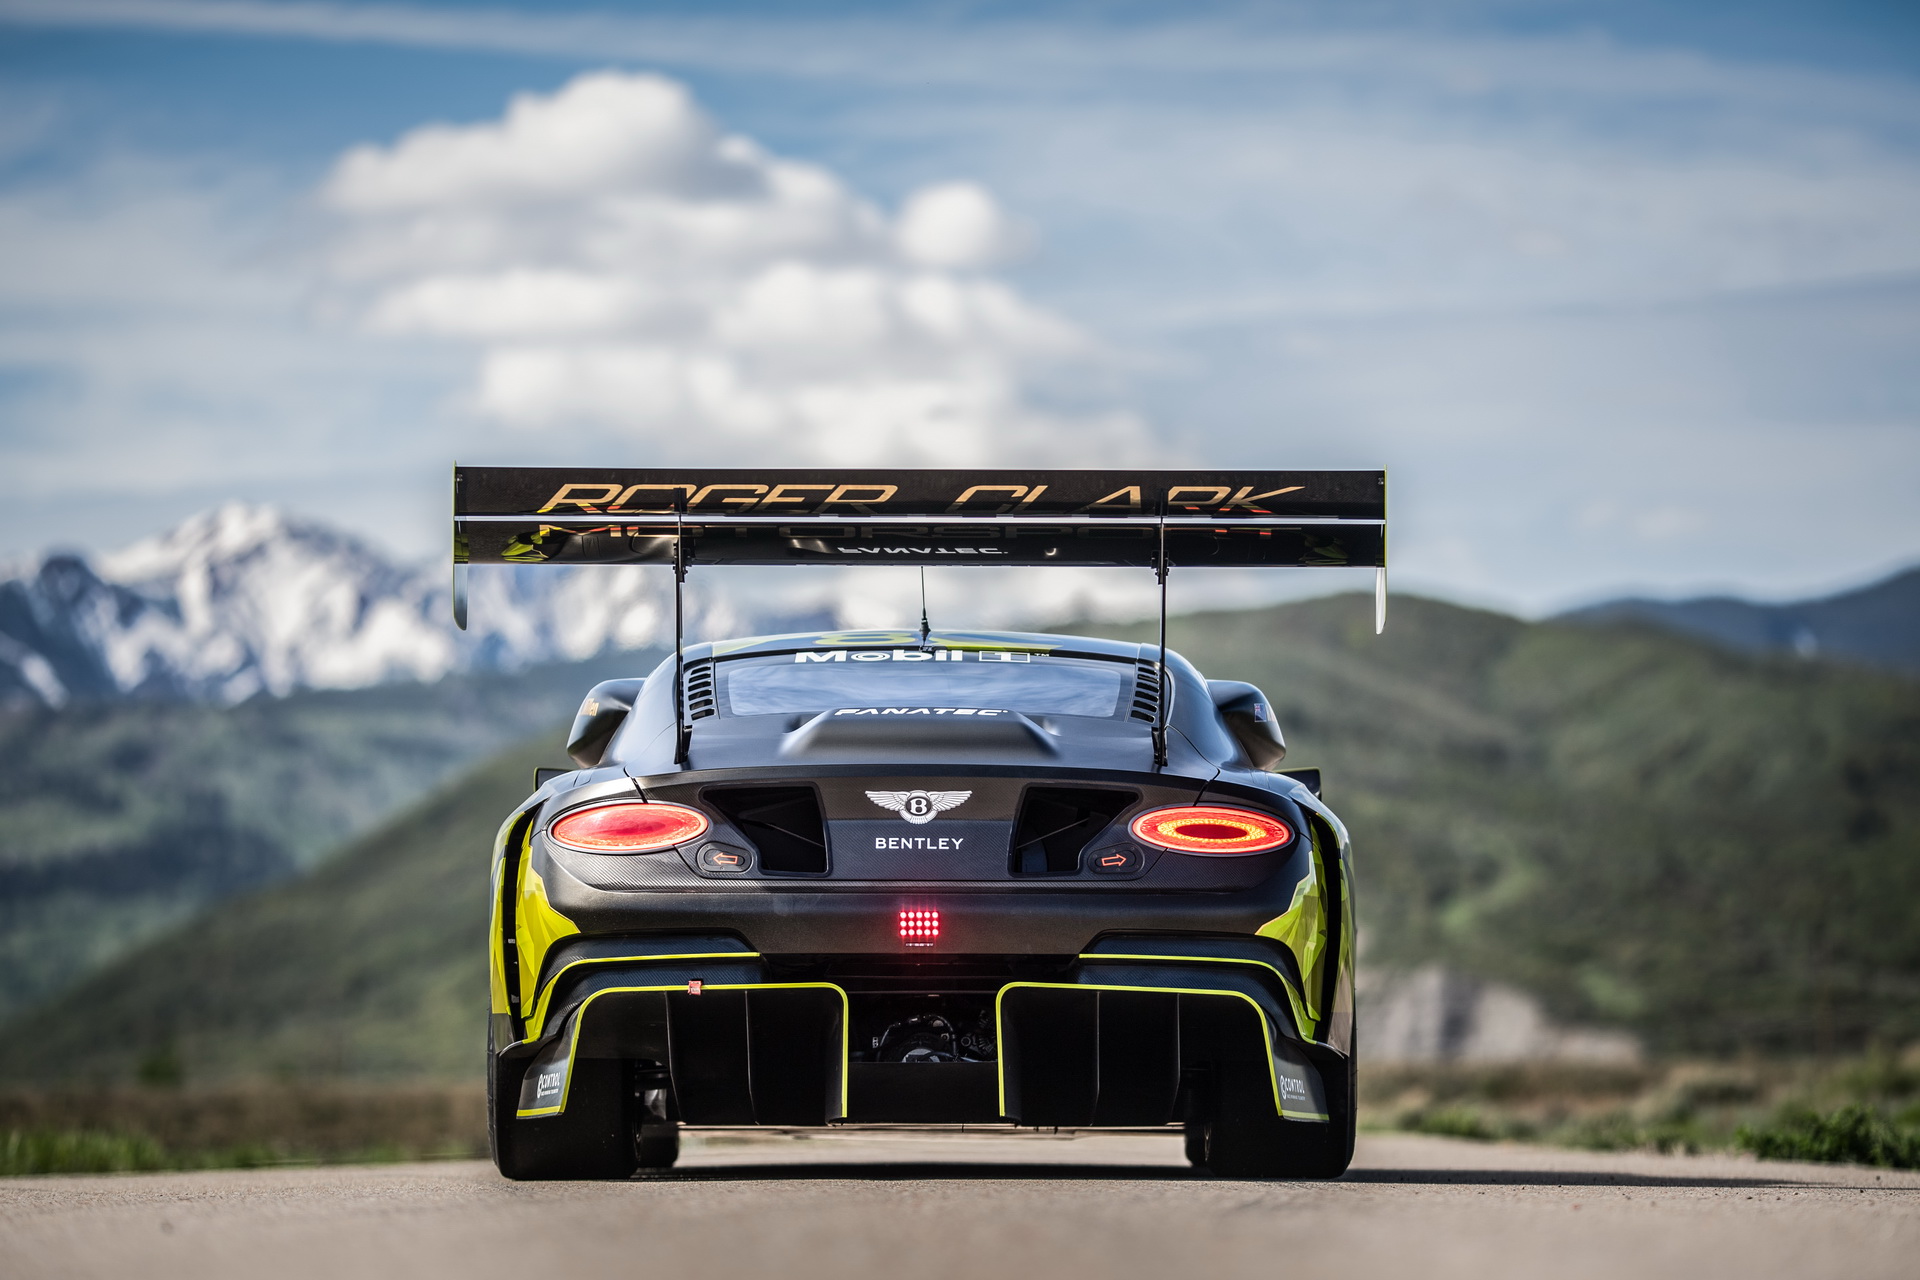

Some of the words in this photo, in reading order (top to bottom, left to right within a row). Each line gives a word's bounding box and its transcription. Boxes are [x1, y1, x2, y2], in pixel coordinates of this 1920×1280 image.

[537, 483, 898, 513] ROGER
[945, 485, 1305, 515] CLARK
[795, 650, 963, 663] Mobil
[834, 708, 1003, 716] FANATEC
[875, 837, 964, 850] BENTLEY
